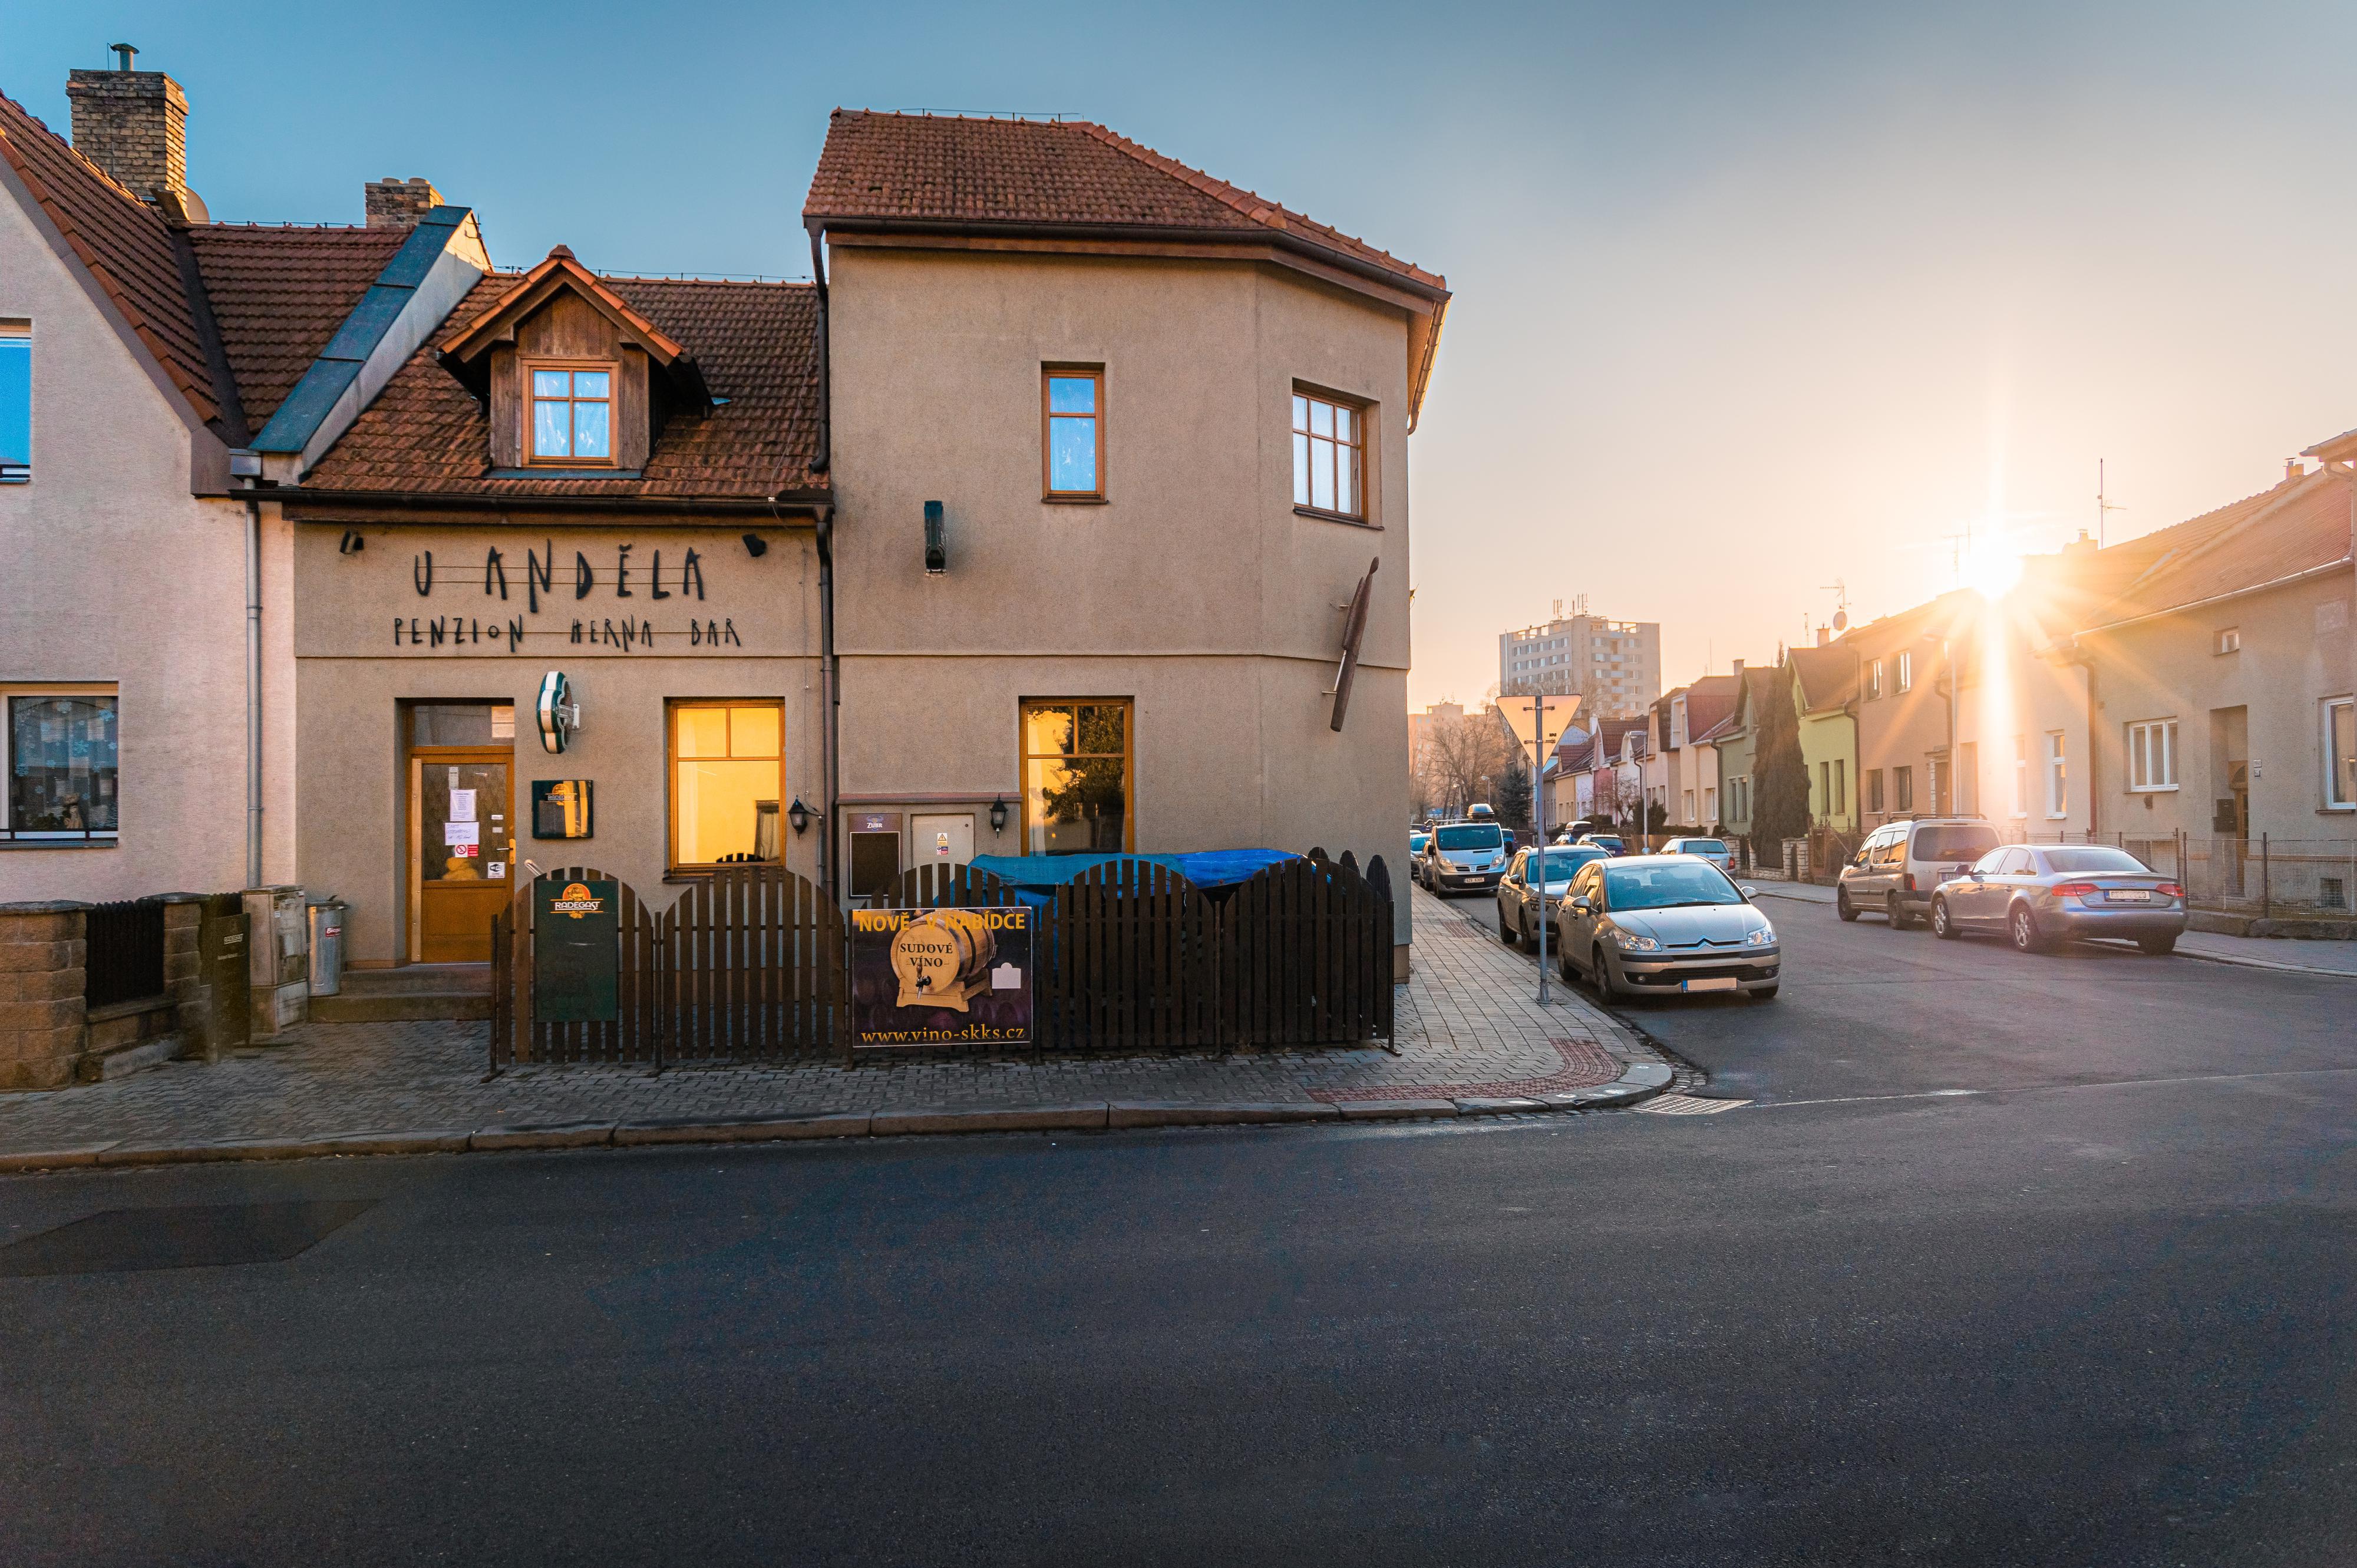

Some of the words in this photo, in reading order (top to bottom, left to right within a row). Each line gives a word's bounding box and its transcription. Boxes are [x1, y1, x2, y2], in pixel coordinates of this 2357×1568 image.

[414, 550, 432, 596] U
[484, 538, 705, 613] ANDĚLA
[394, 613, 524, 652] PENZION
[570, 614, 652, 652] HERNA
[691, 618, 741, 647] BAR
[554, 901, 600, 911] RADEGAST
[859, 912, 910, 932] NOVĚ
[925, 916, 936, 930] V
[946, 911, 1025, 929] NABÍDCE
[899, 943, 953, 953] SUDOVÉ
[909, 955, 943, 967] VÍNO
[861, 1024, 1024, 1042] www.vino-skks.cz
